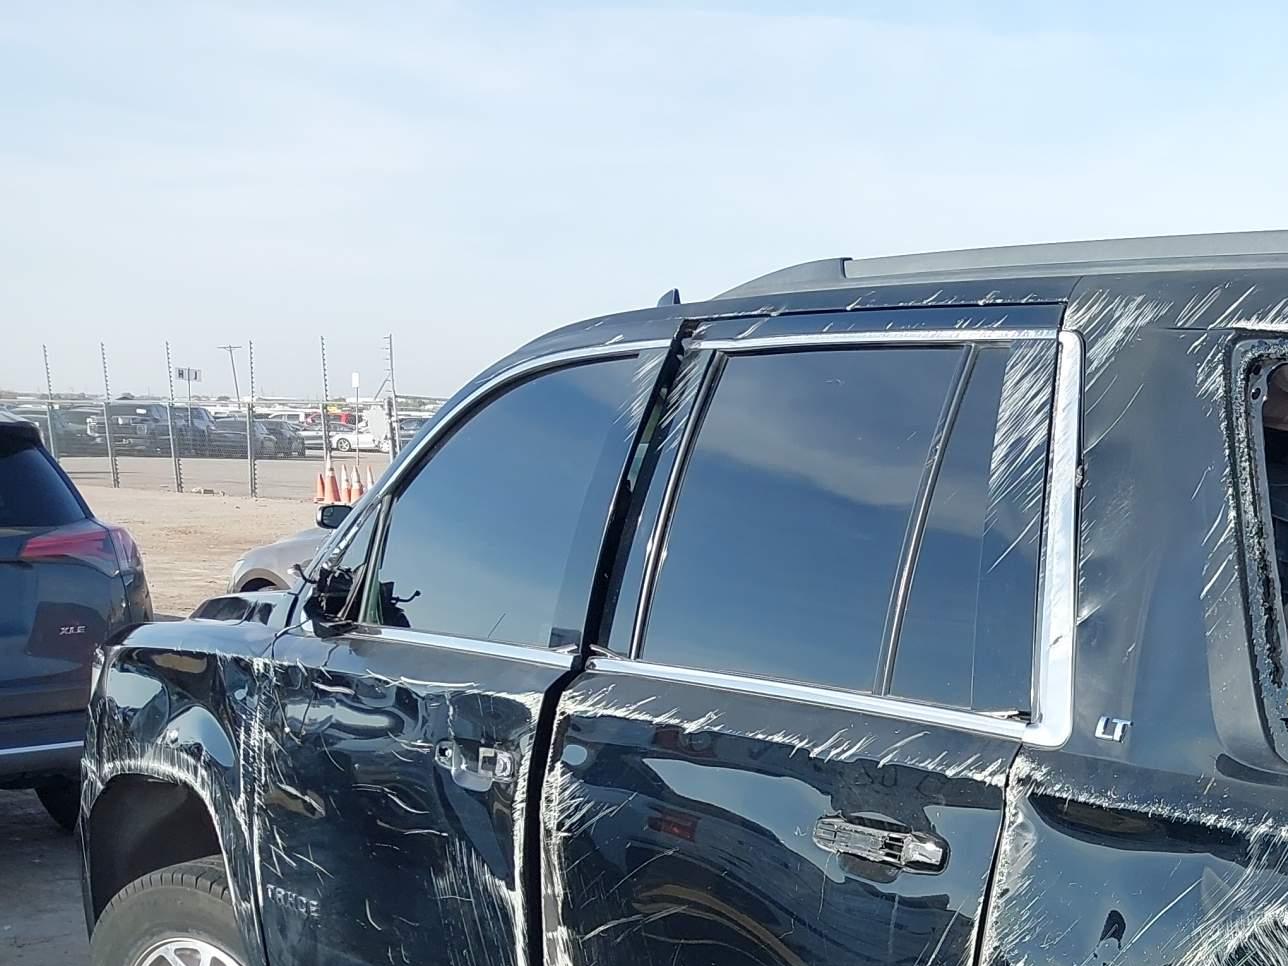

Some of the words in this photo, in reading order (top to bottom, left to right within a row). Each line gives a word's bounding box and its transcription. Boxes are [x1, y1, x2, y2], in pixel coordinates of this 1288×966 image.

[177, 369, 184, 379] H
[59, 625, 87, 636] XLE
[1094, 715, 1132, 743] LT
